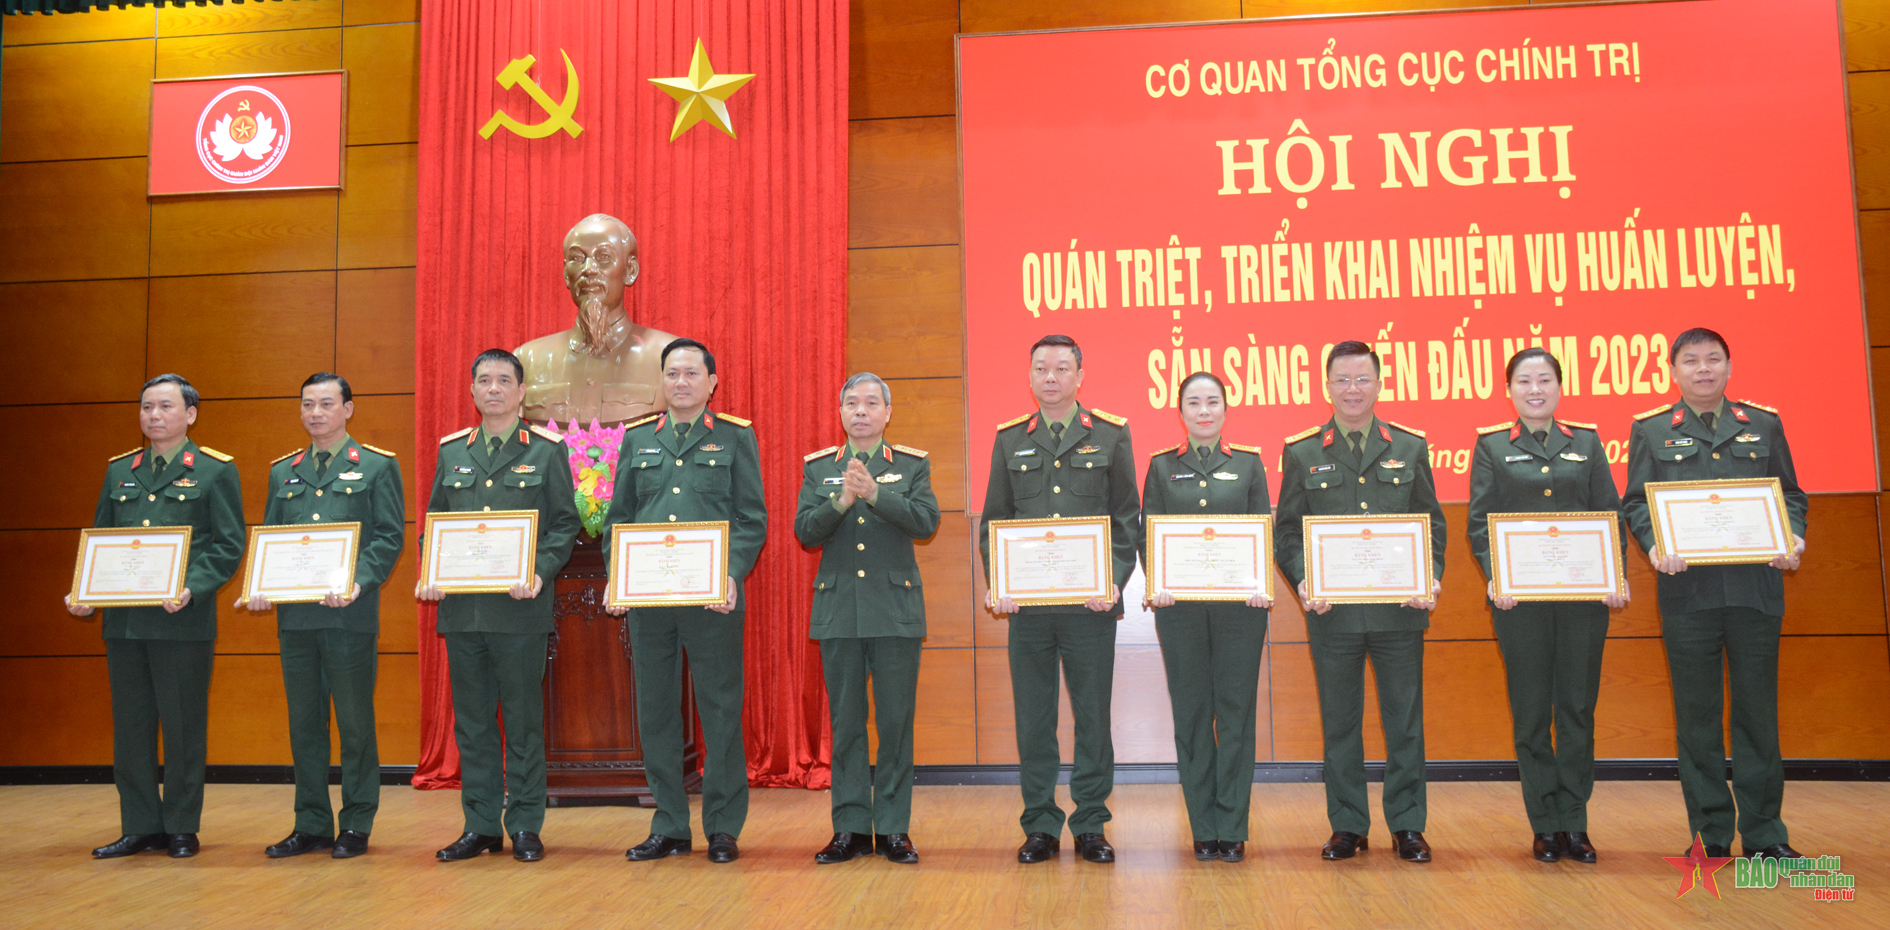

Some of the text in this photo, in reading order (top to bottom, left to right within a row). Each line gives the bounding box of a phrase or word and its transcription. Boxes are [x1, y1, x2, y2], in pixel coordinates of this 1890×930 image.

[1146, 38, 1641, 98] CƠ QUAN TỔNG CỤC CHÍNH TRỊ
[1216, 119, 1576, 209] HỘI NGHỊ
[1023, 208, 1796, 319] QUÁN TRIỆT, TRIỂN KHAI NHIỆM VỤ HUẤN LUYỆN,
[1223, 334, 1311, 407] SÀNG
[1428, 317, 1493, 400] ĐẤU
[1589, 333, 1670, 396] 2023
